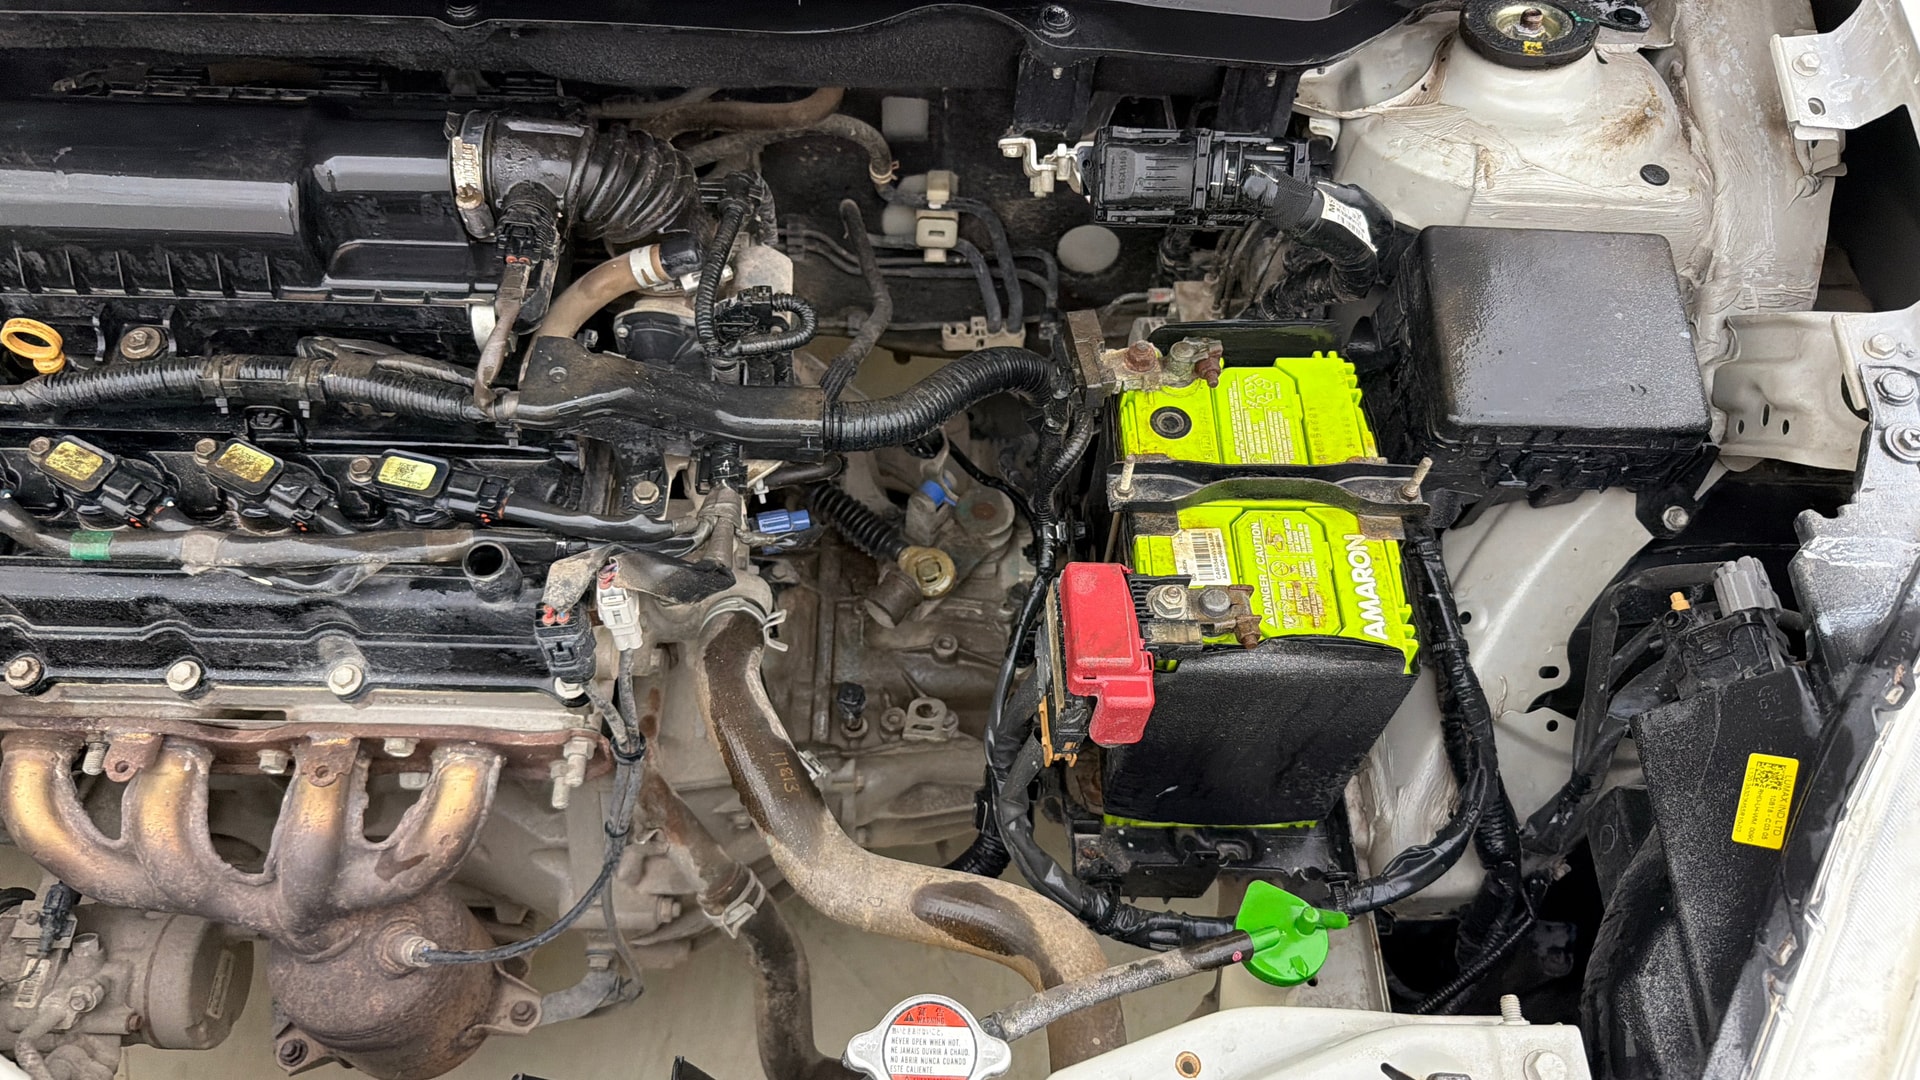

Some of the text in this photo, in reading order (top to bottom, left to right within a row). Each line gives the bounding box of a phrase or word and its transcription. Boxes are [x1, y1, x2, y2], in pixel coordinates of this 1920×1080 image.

[1251, 522, 1265, 565] CAUTION
[1259, 575, 1273, 615] DANGER
[1343, 534, 1388, 640] AMARON
[1780, 775, 1792, 803] LUMAX
[891, 1037, 909, 1045] NEVER
[930, 1038, 946, 1046] WHEN
[950, 1048, 970, 1056] CHAUD.
[901, 1056, 918, 1064] ABRIR
[921, 1057, 940, 1065] NUNCA
